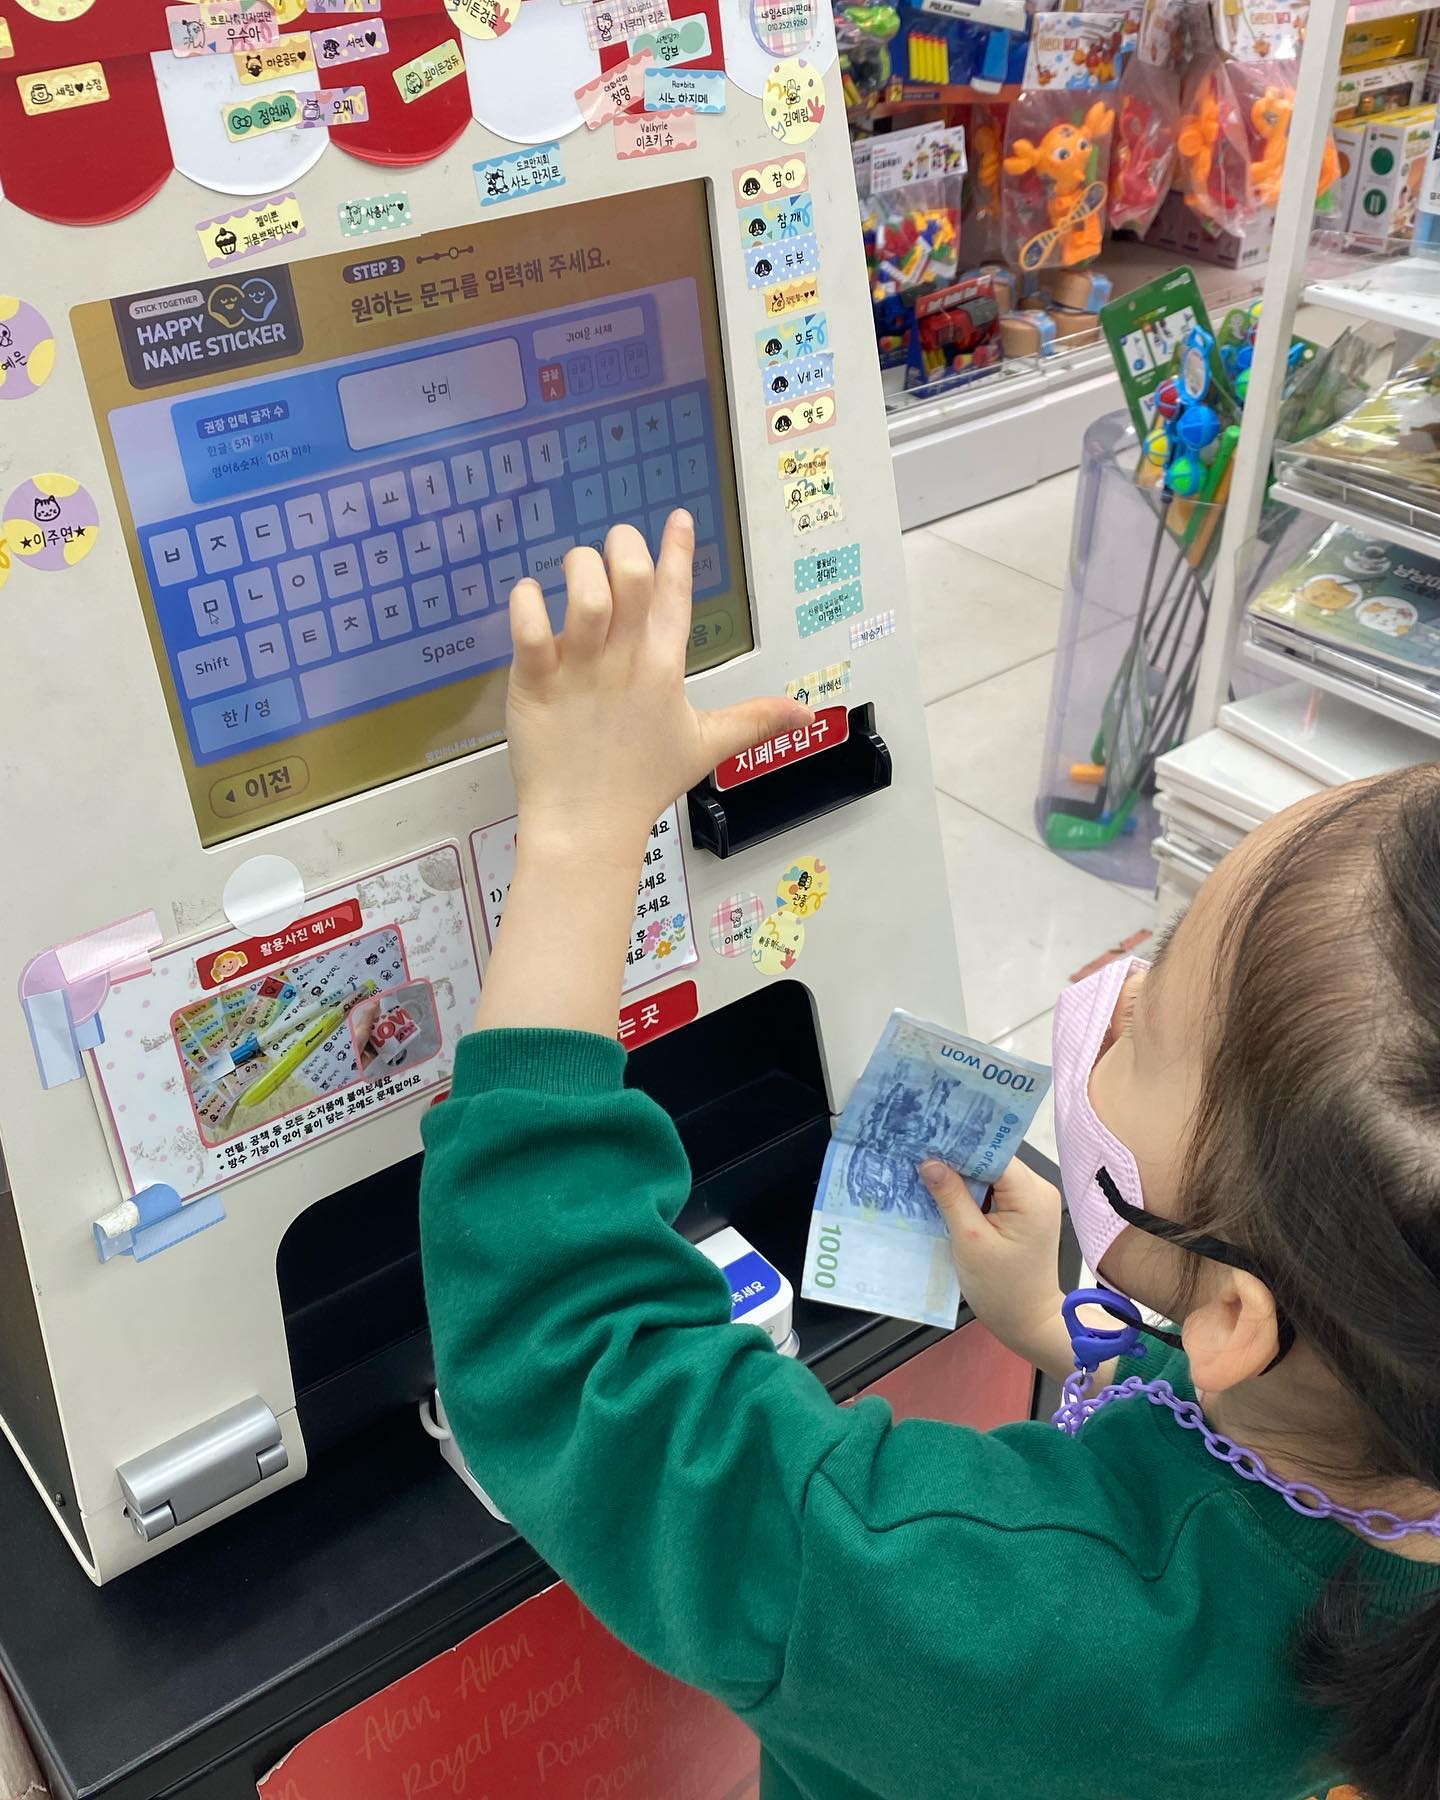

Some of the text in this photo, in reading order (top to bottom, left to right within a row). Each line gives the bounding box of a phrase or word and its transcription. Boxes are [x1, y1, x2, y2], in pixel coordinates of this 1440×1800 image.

[619, 11, 667, 33] 사쿠마 리츠
[226, 26, 261, 44] 우수아
[660, 46, 680, 61] 당보
[610, 87, 632, 107] 청명
[678, 93, 709, 104] 하지메
[640, 121, 668, 135] Valkyrie
[783, 107, 809, 128] 김예림
[636, 132, 674, 150] 이츠키 슈
[511, 167, 562, 190] 사노 만지로
[352, 259, 400, 281] STEP 3
[351, 246, 612, 324] 원하는 문구를 입력해 주세요.
[134, 294, 198, 315] STICK TOGETHER
[136, 314, 204, 346] HAPPY
[143, 322, 287, 371] NAME STICKER
[204, 405, 285, 435] 권장 입력 글자 수
[267, 449, 289, 463] 10자
[33, 526, 74, 548] 이주연
[817, 567, 838, 582] 정대만
[421, 635, 476, 665] Space
[194, 656, 230, 676] Shift
[735, 718, 830, 773] 지폐투입구
[244, 766, 293, 801] 이전
[636, 895, 671, 919] 주세요
[260, 917, 337, 957] 활용사진 예시
[636, 929, 648, 943] 후
[640, 1003, 660, 1030] 곳
[941, 1045, 1036, 1093] 1000 won
[225, 1141, 248, 1158] 연필,
[250, 1130, 270, 1145] 공책
[272, 1124, 283, 1136] 등
[285, 1114, 305, 1130] 모든
[307, 1097, 345, 1119] 소지품에
[228, 1154, 248, 1169] 방수
[250, 1139, 280, 1158] 기능이
[282, 1129, 302, 1145] 있어
[303, 1119, 323, 1135] 물이
[347, 1095, 375, 1115] 곳에도
[376, 1074, 422, 1101] 문제없어요
[989, 1125, 1011, 1151] Bank
[814, 1224, 842, 1289] 1000
[453, 1632, 534, 1700] Allan
[402, 1727, 493, 1796] Royal
[500, 1656, 586, 1740] Blood
